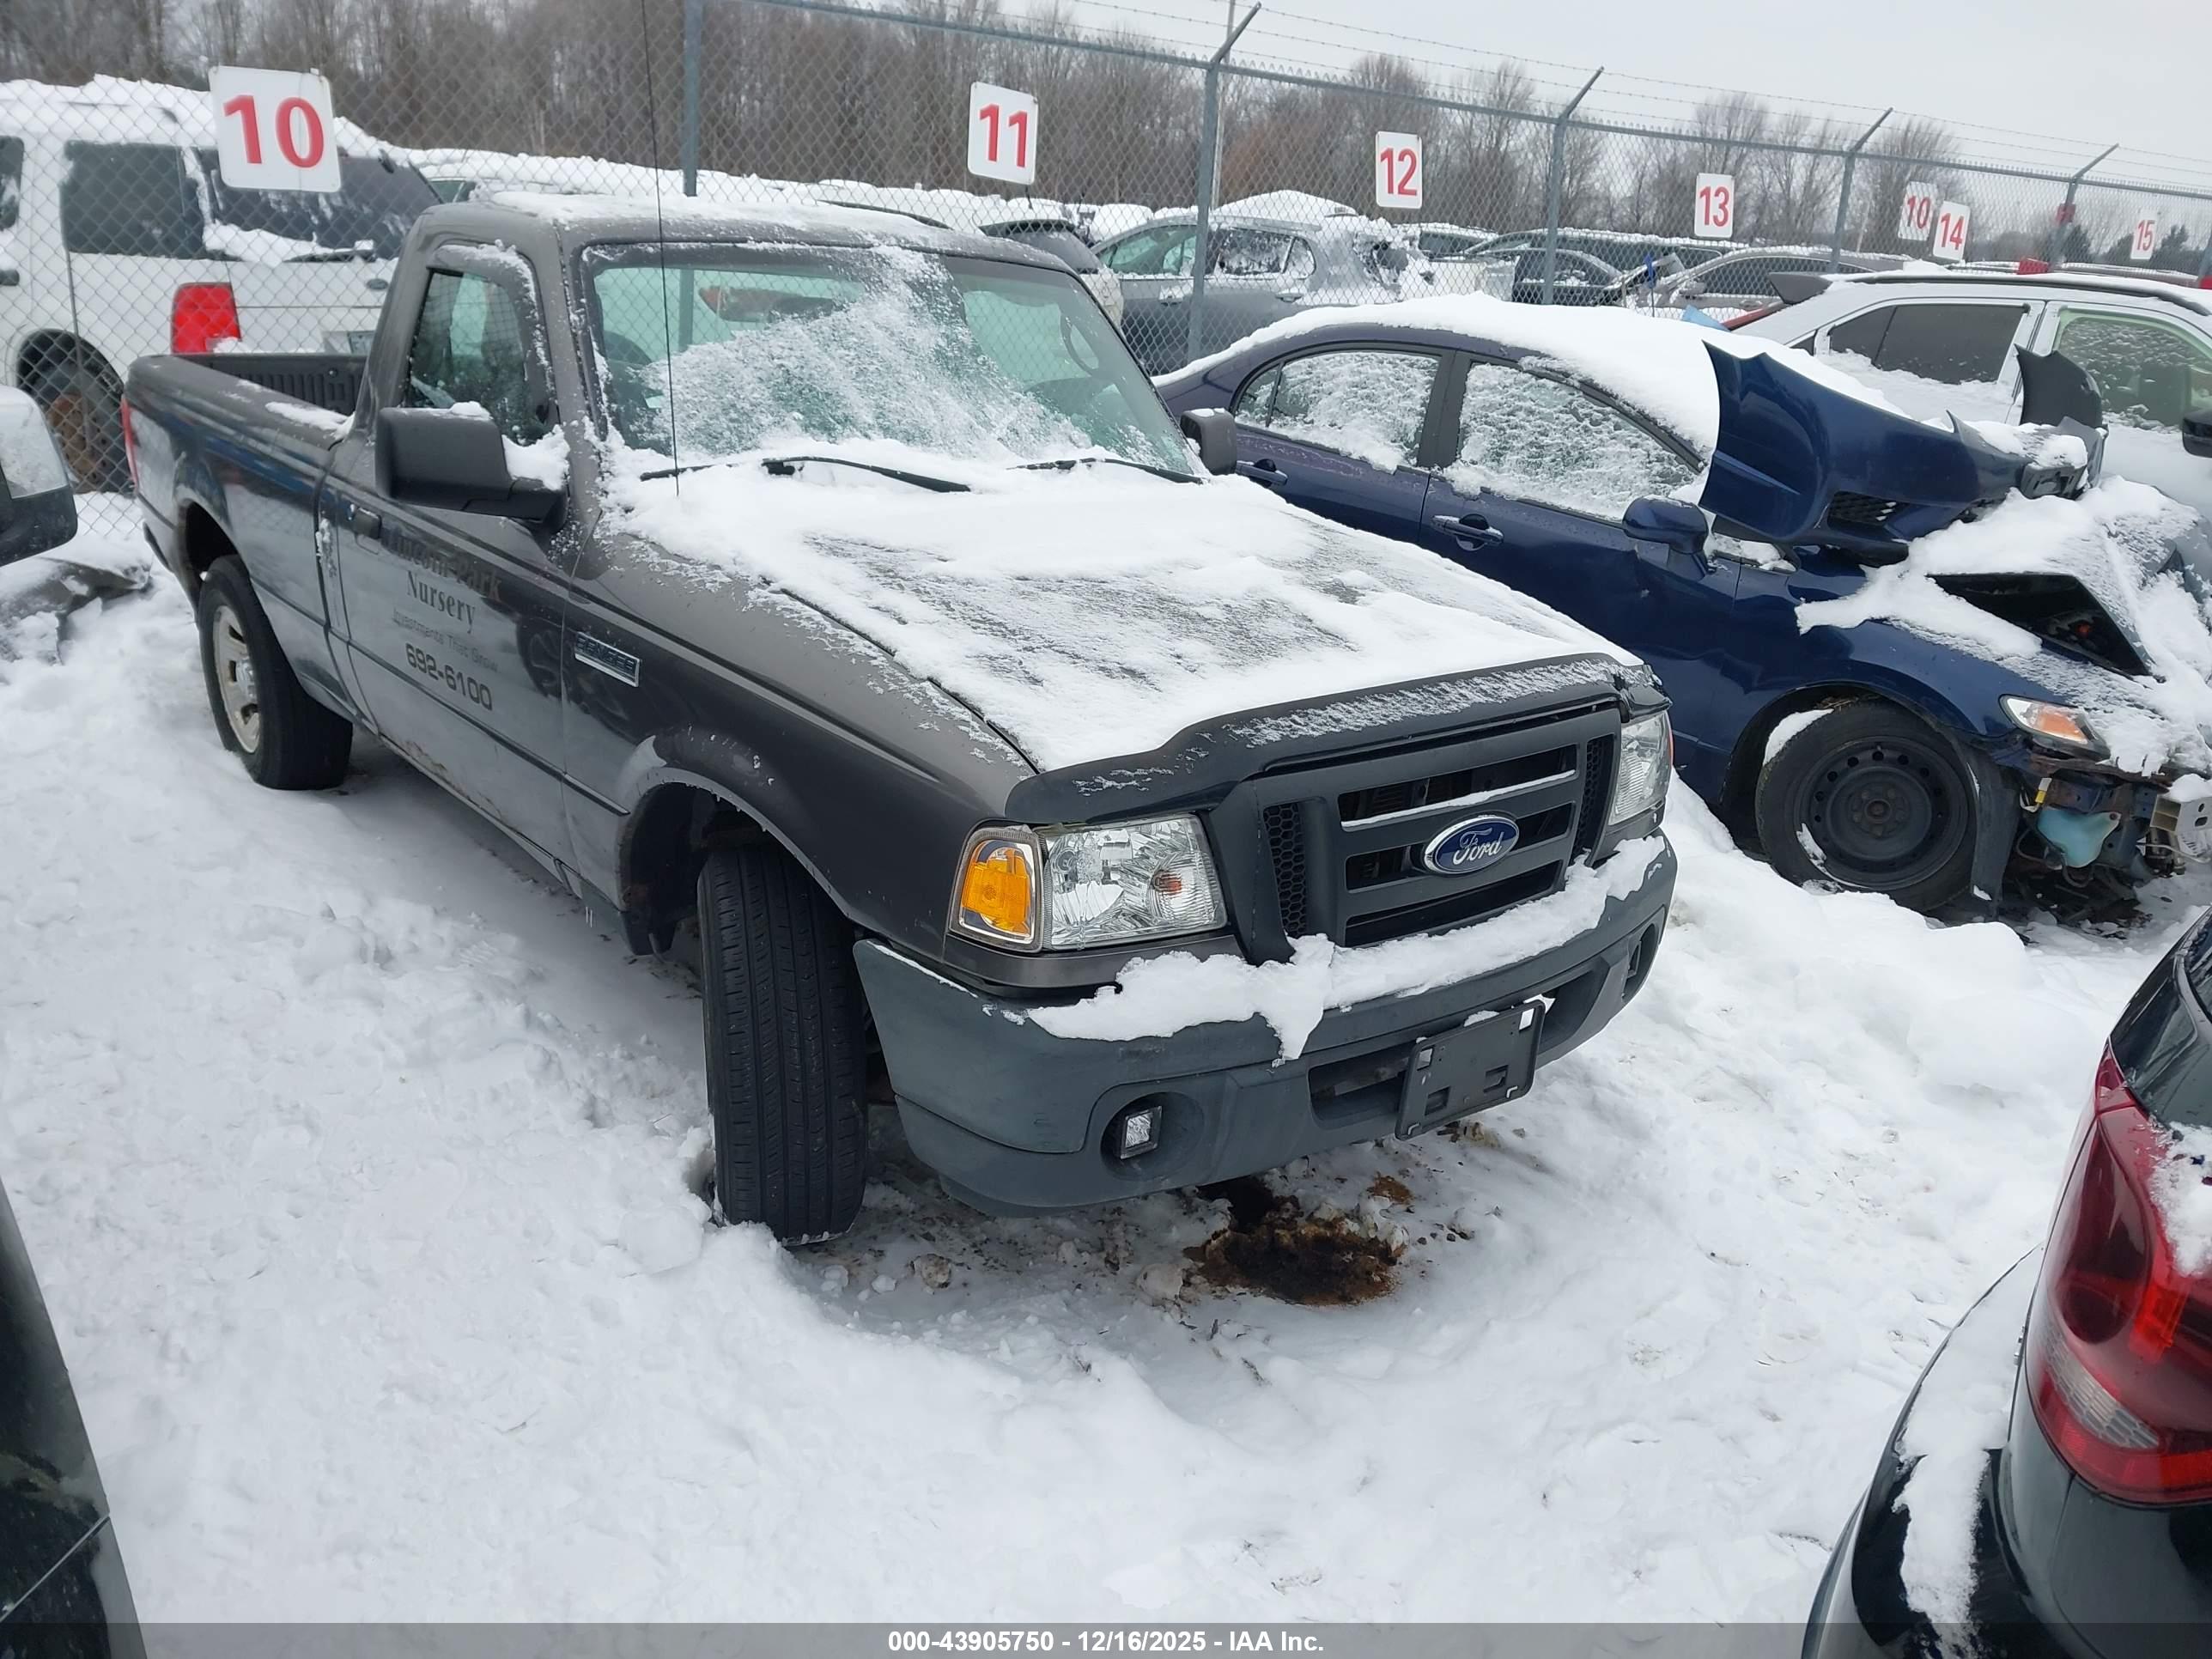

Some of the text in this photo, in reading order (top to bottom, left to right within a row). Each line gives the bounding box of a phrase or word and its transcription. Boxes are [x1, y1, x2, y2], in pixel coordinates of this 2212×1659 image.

[224, 95, 325, 168] 10
[979, 103, 1029, 168] 11
[1379, 147, 1418, 196] 12
[1698, 185, 1730, 228] 13
[1907, 195, 1931, 229] 10
[1941, 212, 1965, 250] 14
[2136, 219, 2156, 252] 15
[407, 570, 476, 633] Nursery
[406, 642, 493, 711] 692-6100
[1453, 828, 1504, 866] Ford
